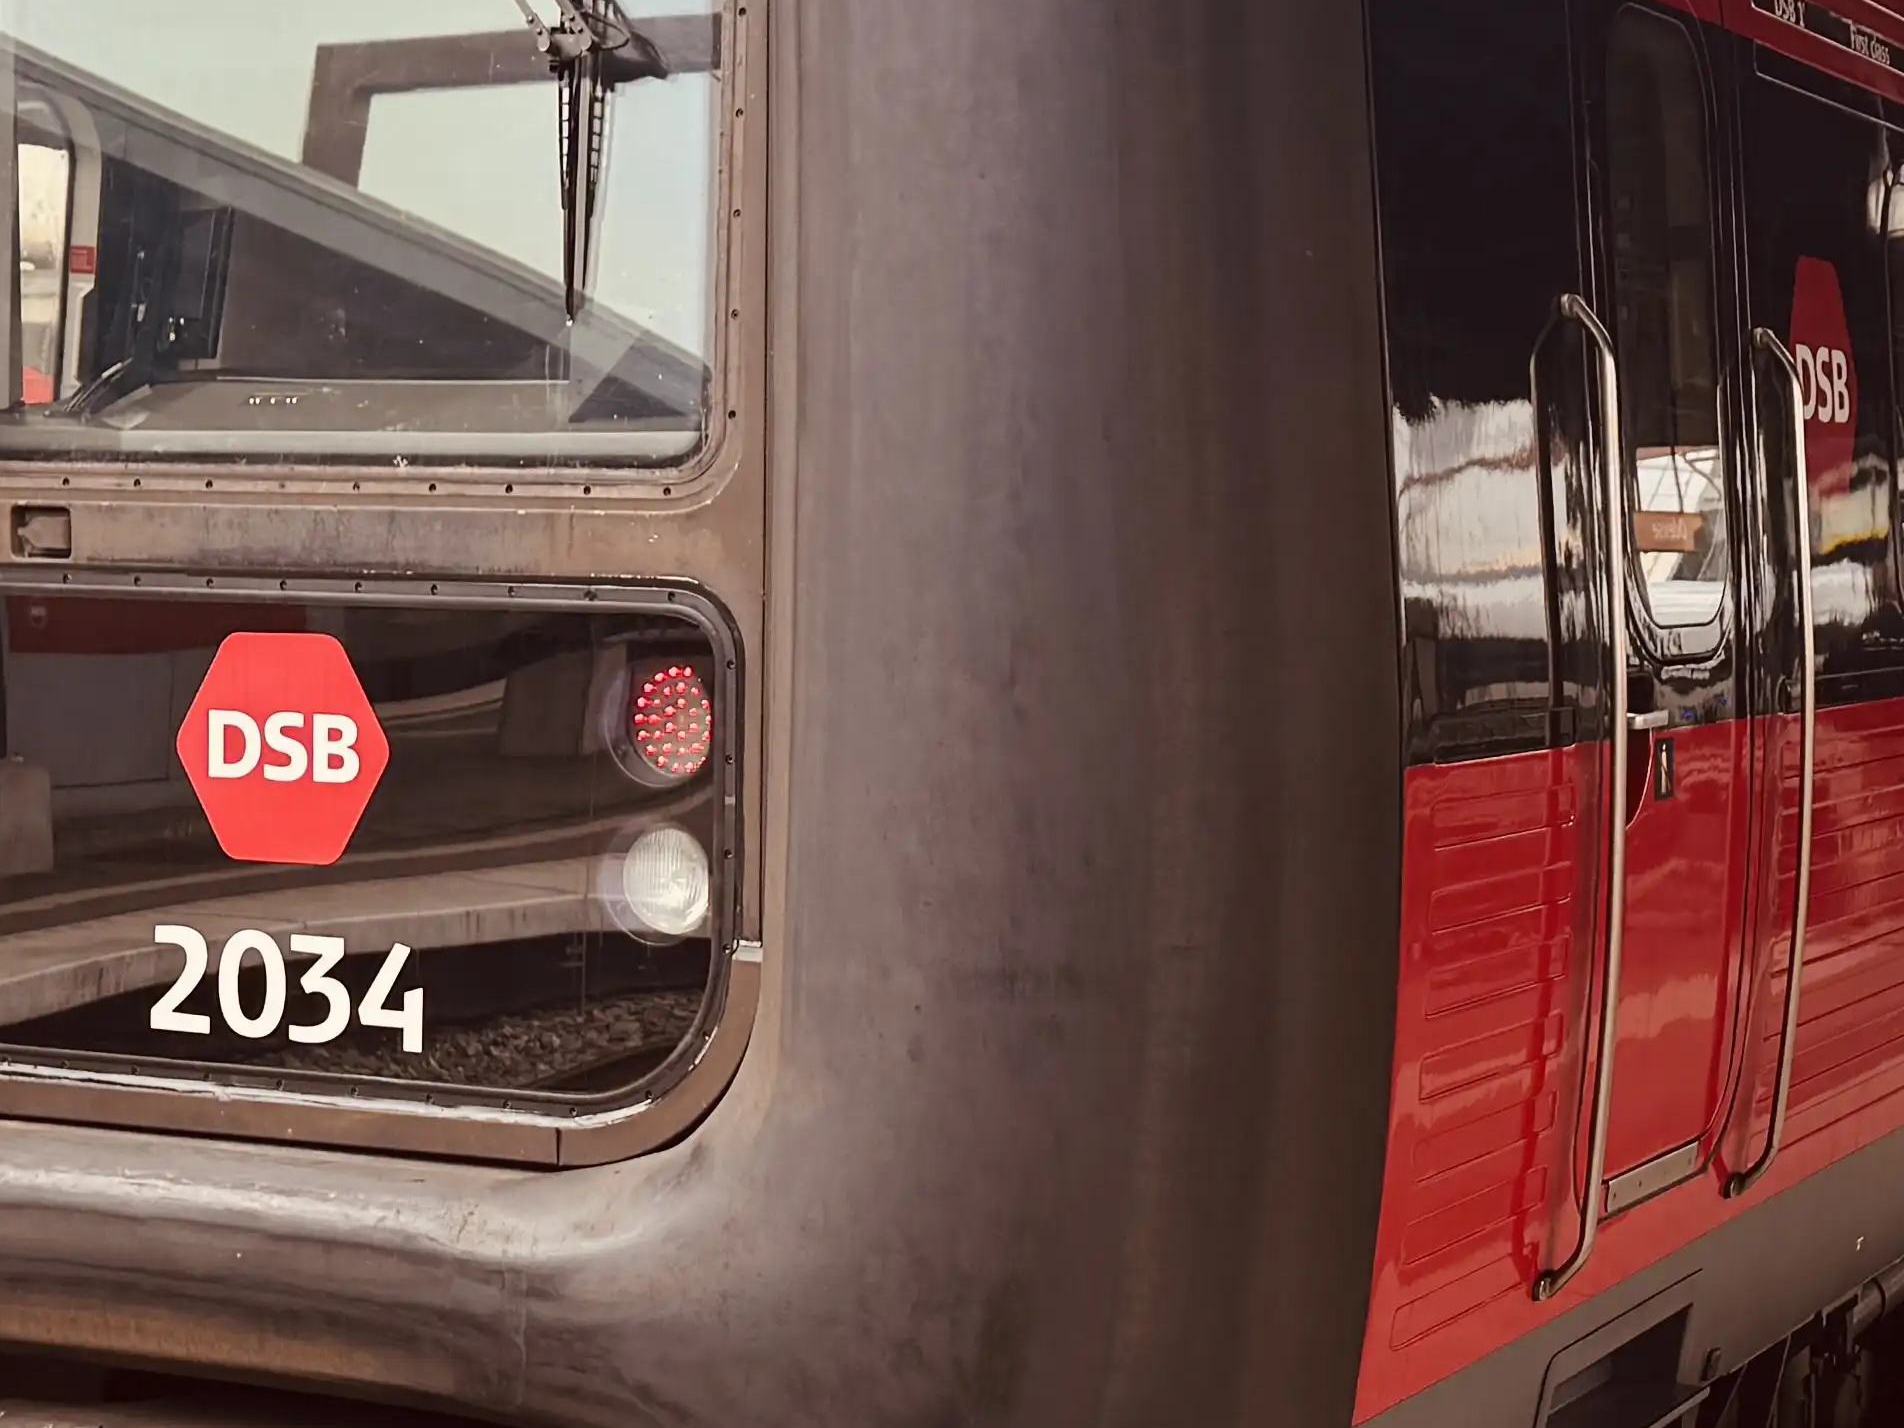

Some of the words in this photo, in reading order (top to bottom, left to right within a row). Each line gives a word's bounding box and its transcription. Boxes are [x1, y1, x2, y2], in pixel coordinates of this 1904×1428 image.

[1796, 343, 1850, 423] DSB
[208, 709, 360, 783] DSB
[150, 925, 424, 1053] 2034
